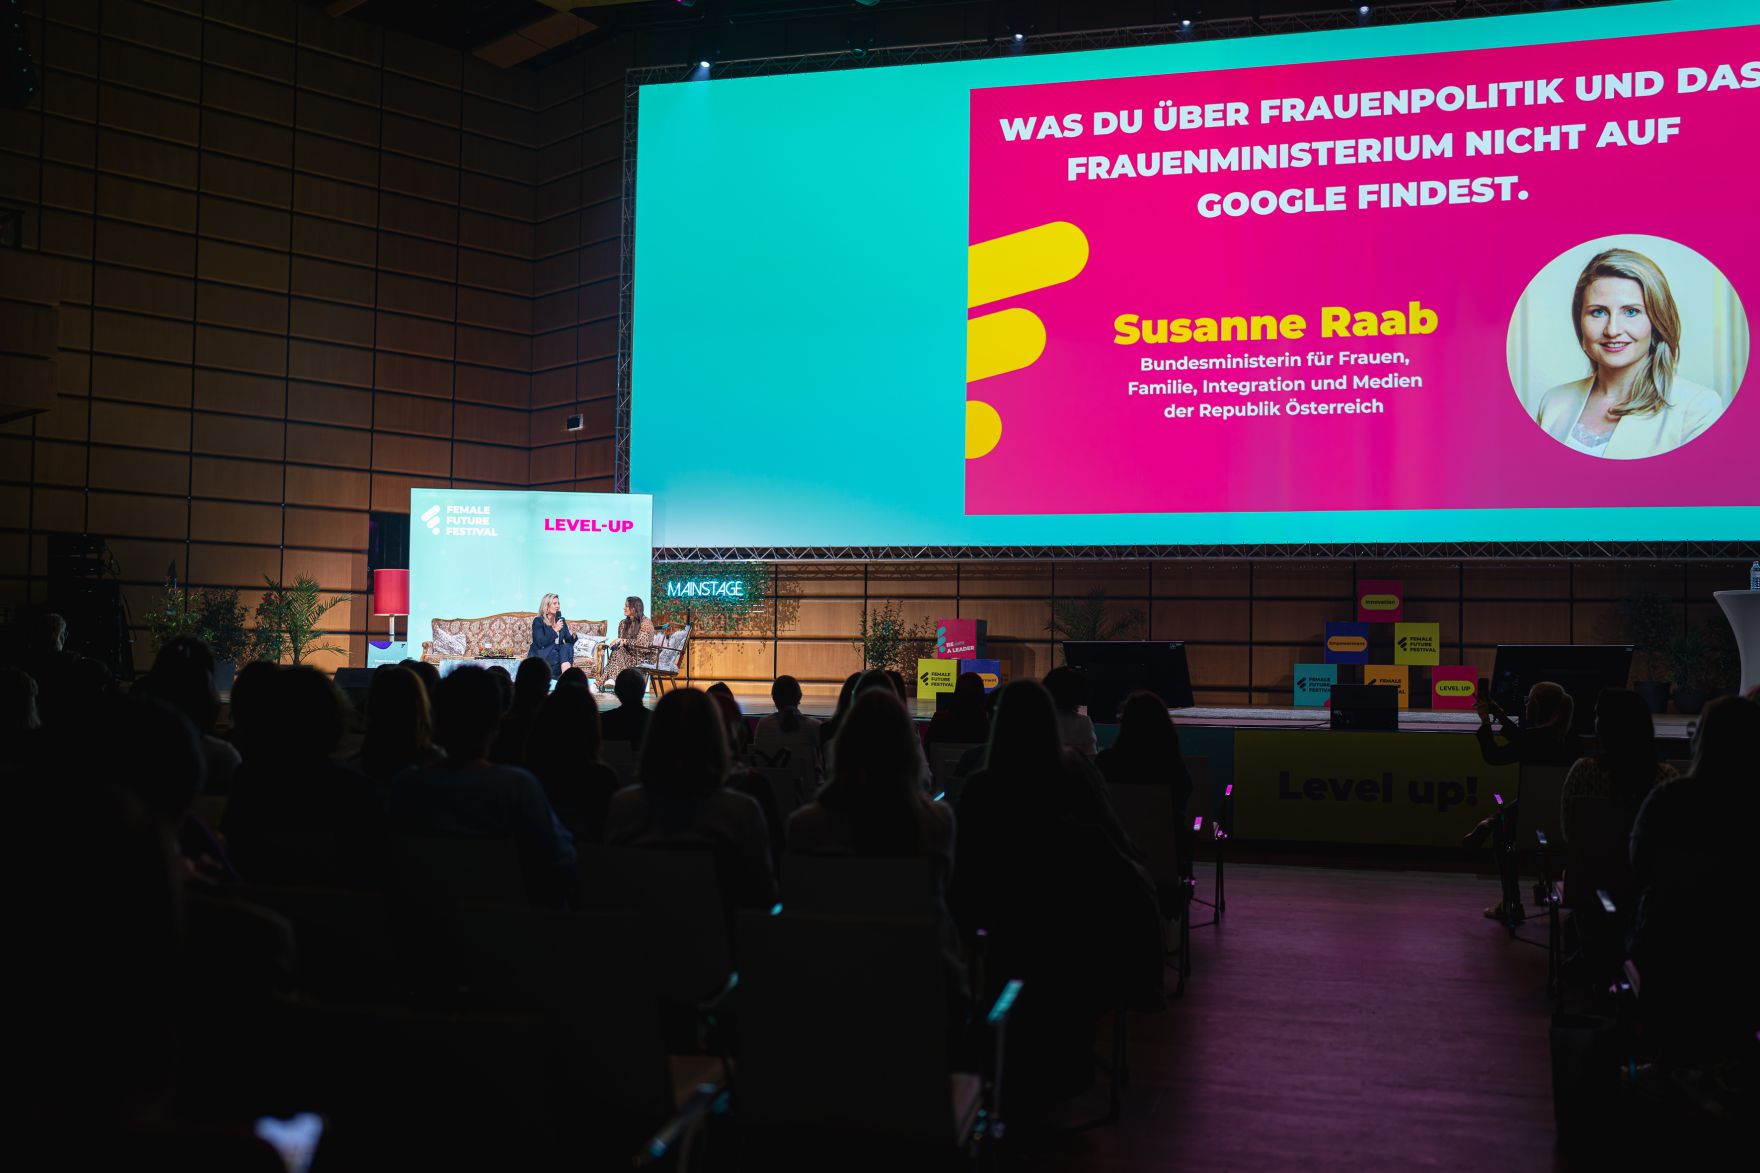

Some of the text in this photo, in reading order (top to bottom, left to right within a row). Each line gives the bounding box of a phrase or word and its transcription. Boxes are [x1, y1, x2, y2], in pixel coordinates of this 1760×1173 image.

[1000, 61, 1760, 141] WAS DU ÜBER FRAUENPOLITIK UND DAS
[1067, 116, 1681, 181] FRAUENMINISTERIUM NICHT AUF
[1197, 175, 1529, 219] GOOGLE FINDEST.
[1113, 300, 1439, 346] Susanne Raab
[1140, 350, 1410, 372] Bundesministerin für Frauen,
[1128, 372, 1423, 398] Familie, Integration und Medien
[1163, 397, 1384, 421] der Republik Österreich
[446, 505, 490, 515] FEMALE
[446, 516, 490, 526] FUTURE
[445, 526, 499, 537] FESTIVAL
[544, 518, 634, 533] LEVEL-UP
[667, 580, 744, 597] MAINSTAGE
[952, 645, 975, 653] LEADER
[1279, 770, 1478, 812] Level up!
